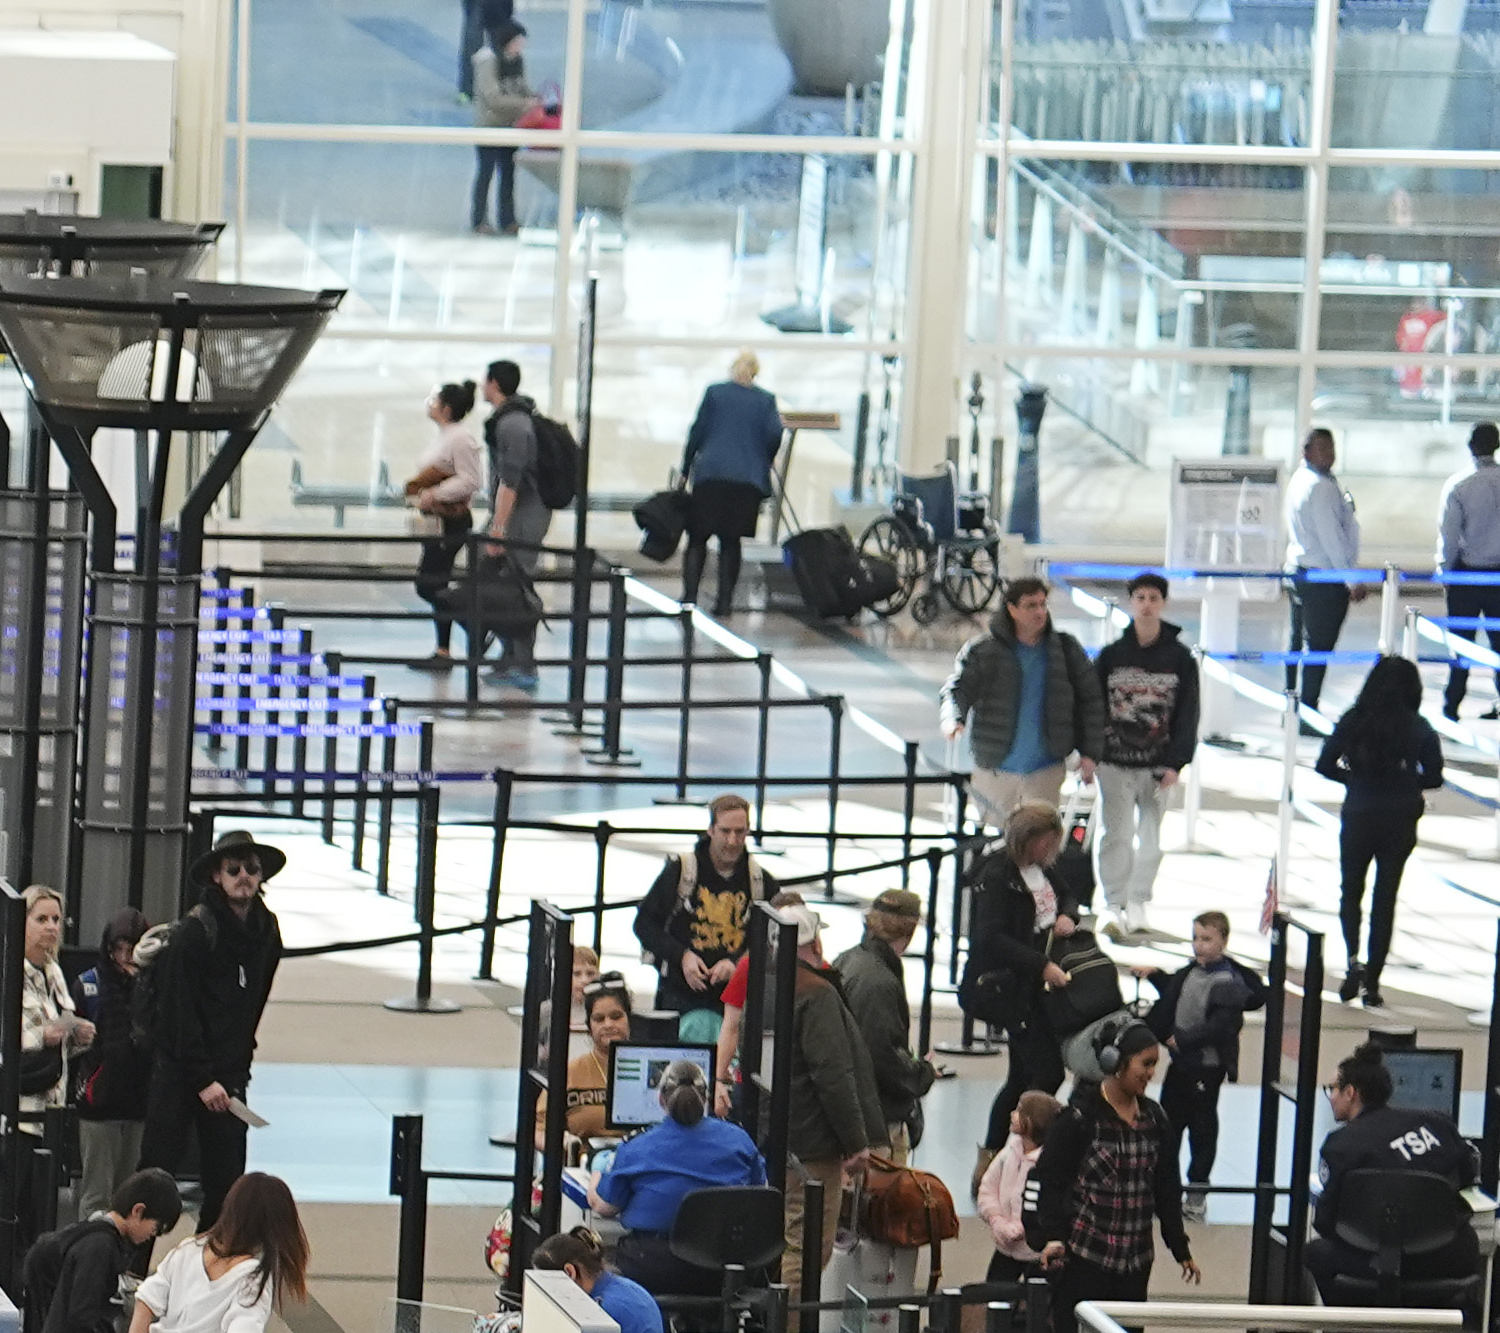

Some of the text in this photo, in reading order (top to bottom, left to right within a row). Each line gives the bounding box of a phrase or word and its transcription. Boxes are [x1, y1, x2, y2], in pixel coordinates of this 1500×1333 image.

[308, 700, 329, 711] EXIT
[357, 726, 376, 737] EXIT
[1389, 1123, 1440, 1163] TSA
